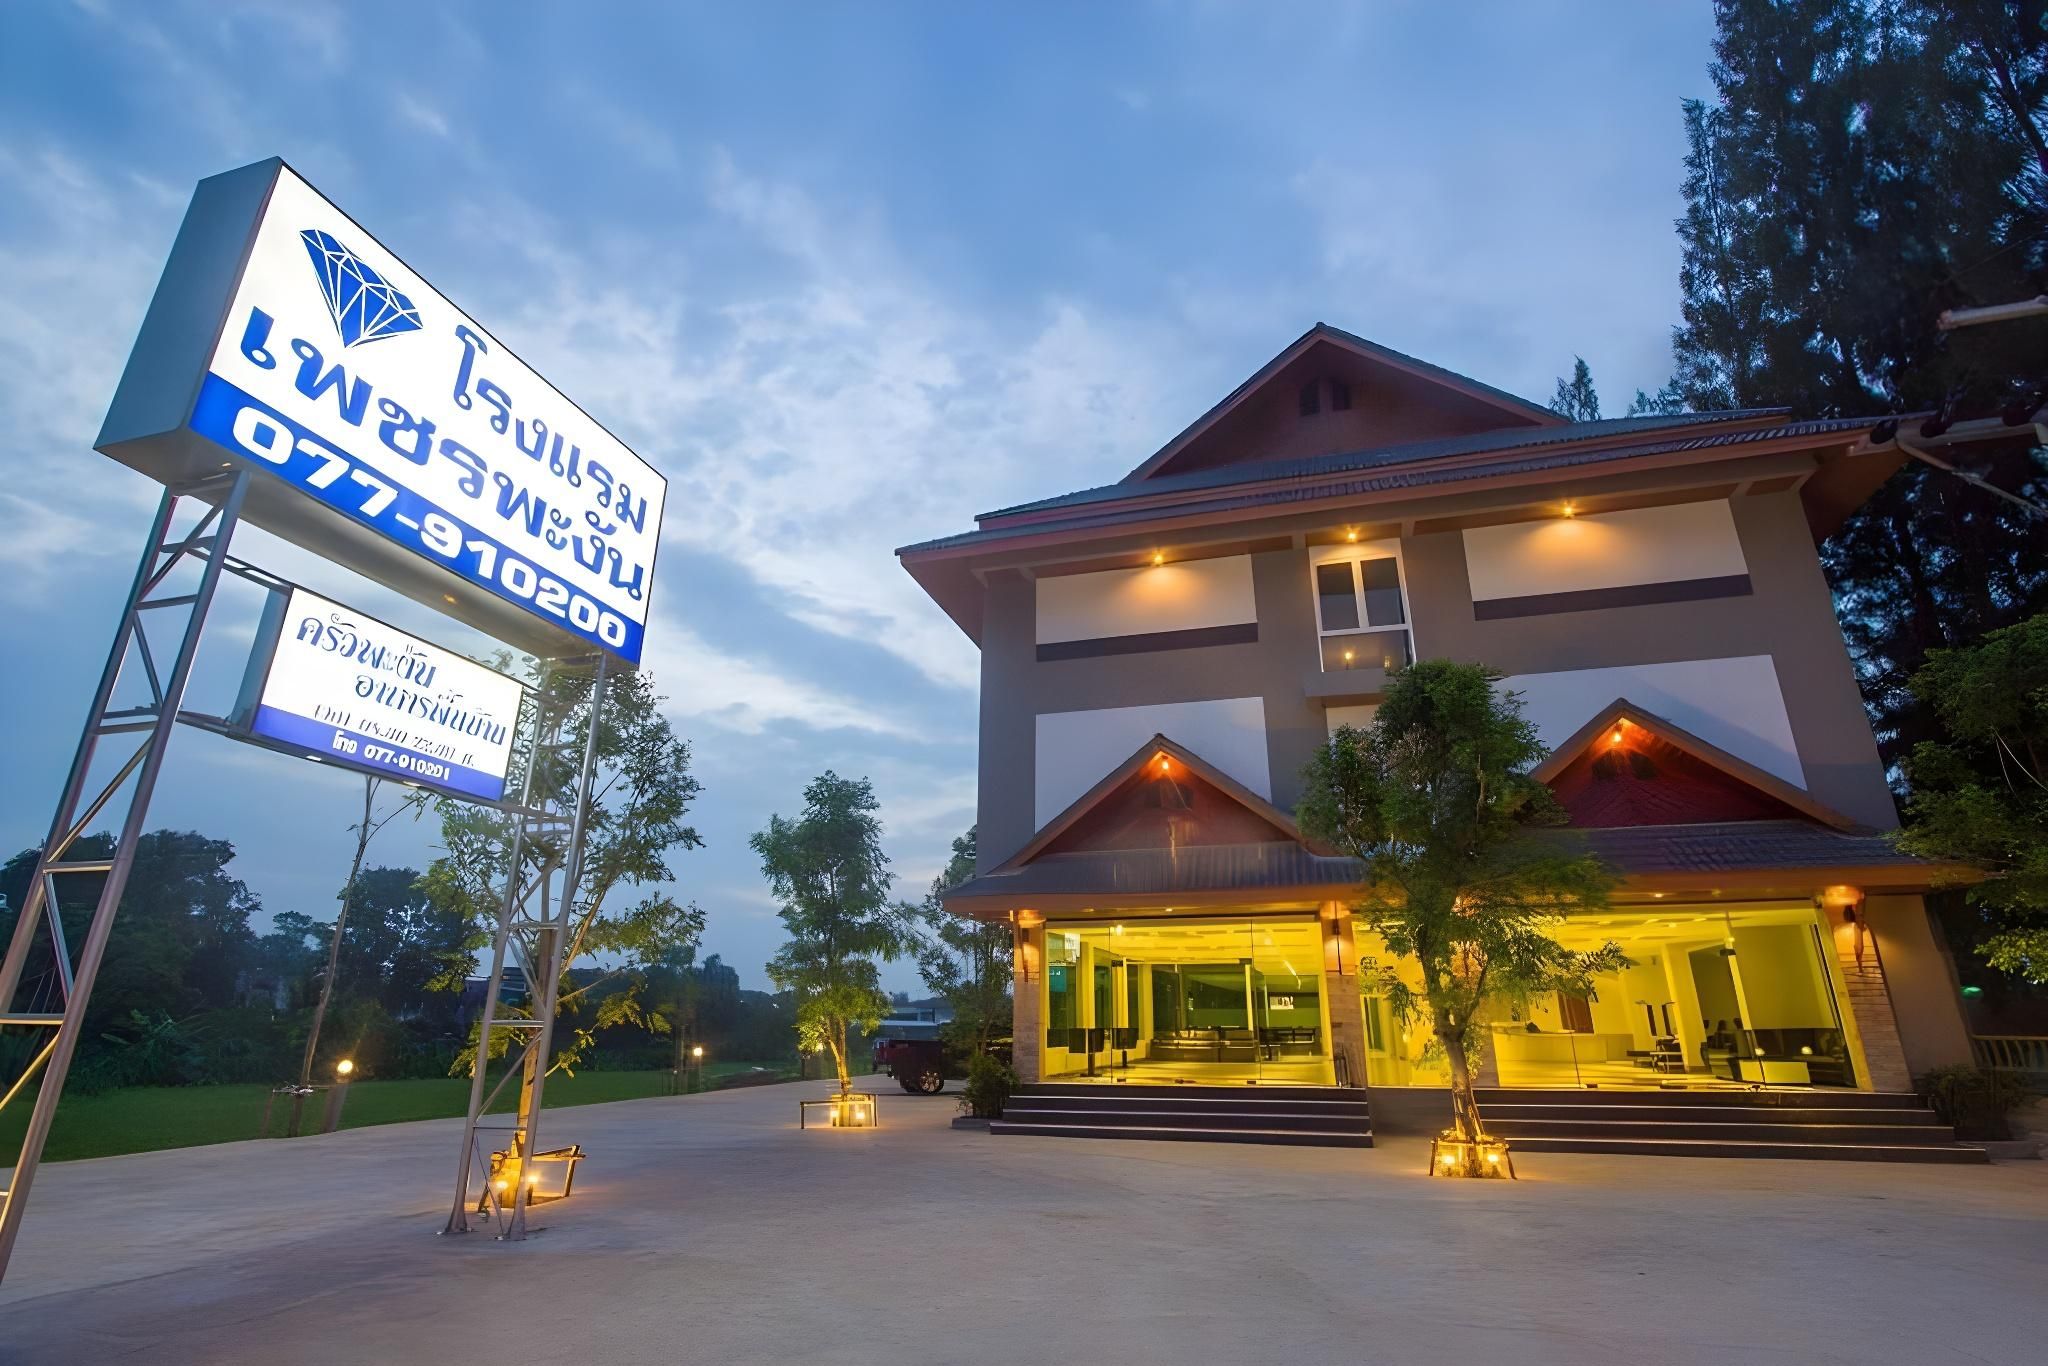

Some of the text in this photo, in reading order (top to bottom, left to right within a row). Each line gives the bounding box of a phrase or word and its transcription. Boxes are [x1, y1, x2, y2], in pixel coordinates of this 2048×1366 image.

[232, 406, 626, 648] 077-910200
[240, 305, 644, 601] เพชรพะงัน
[453, 324, 647, 534] โรงแรม
